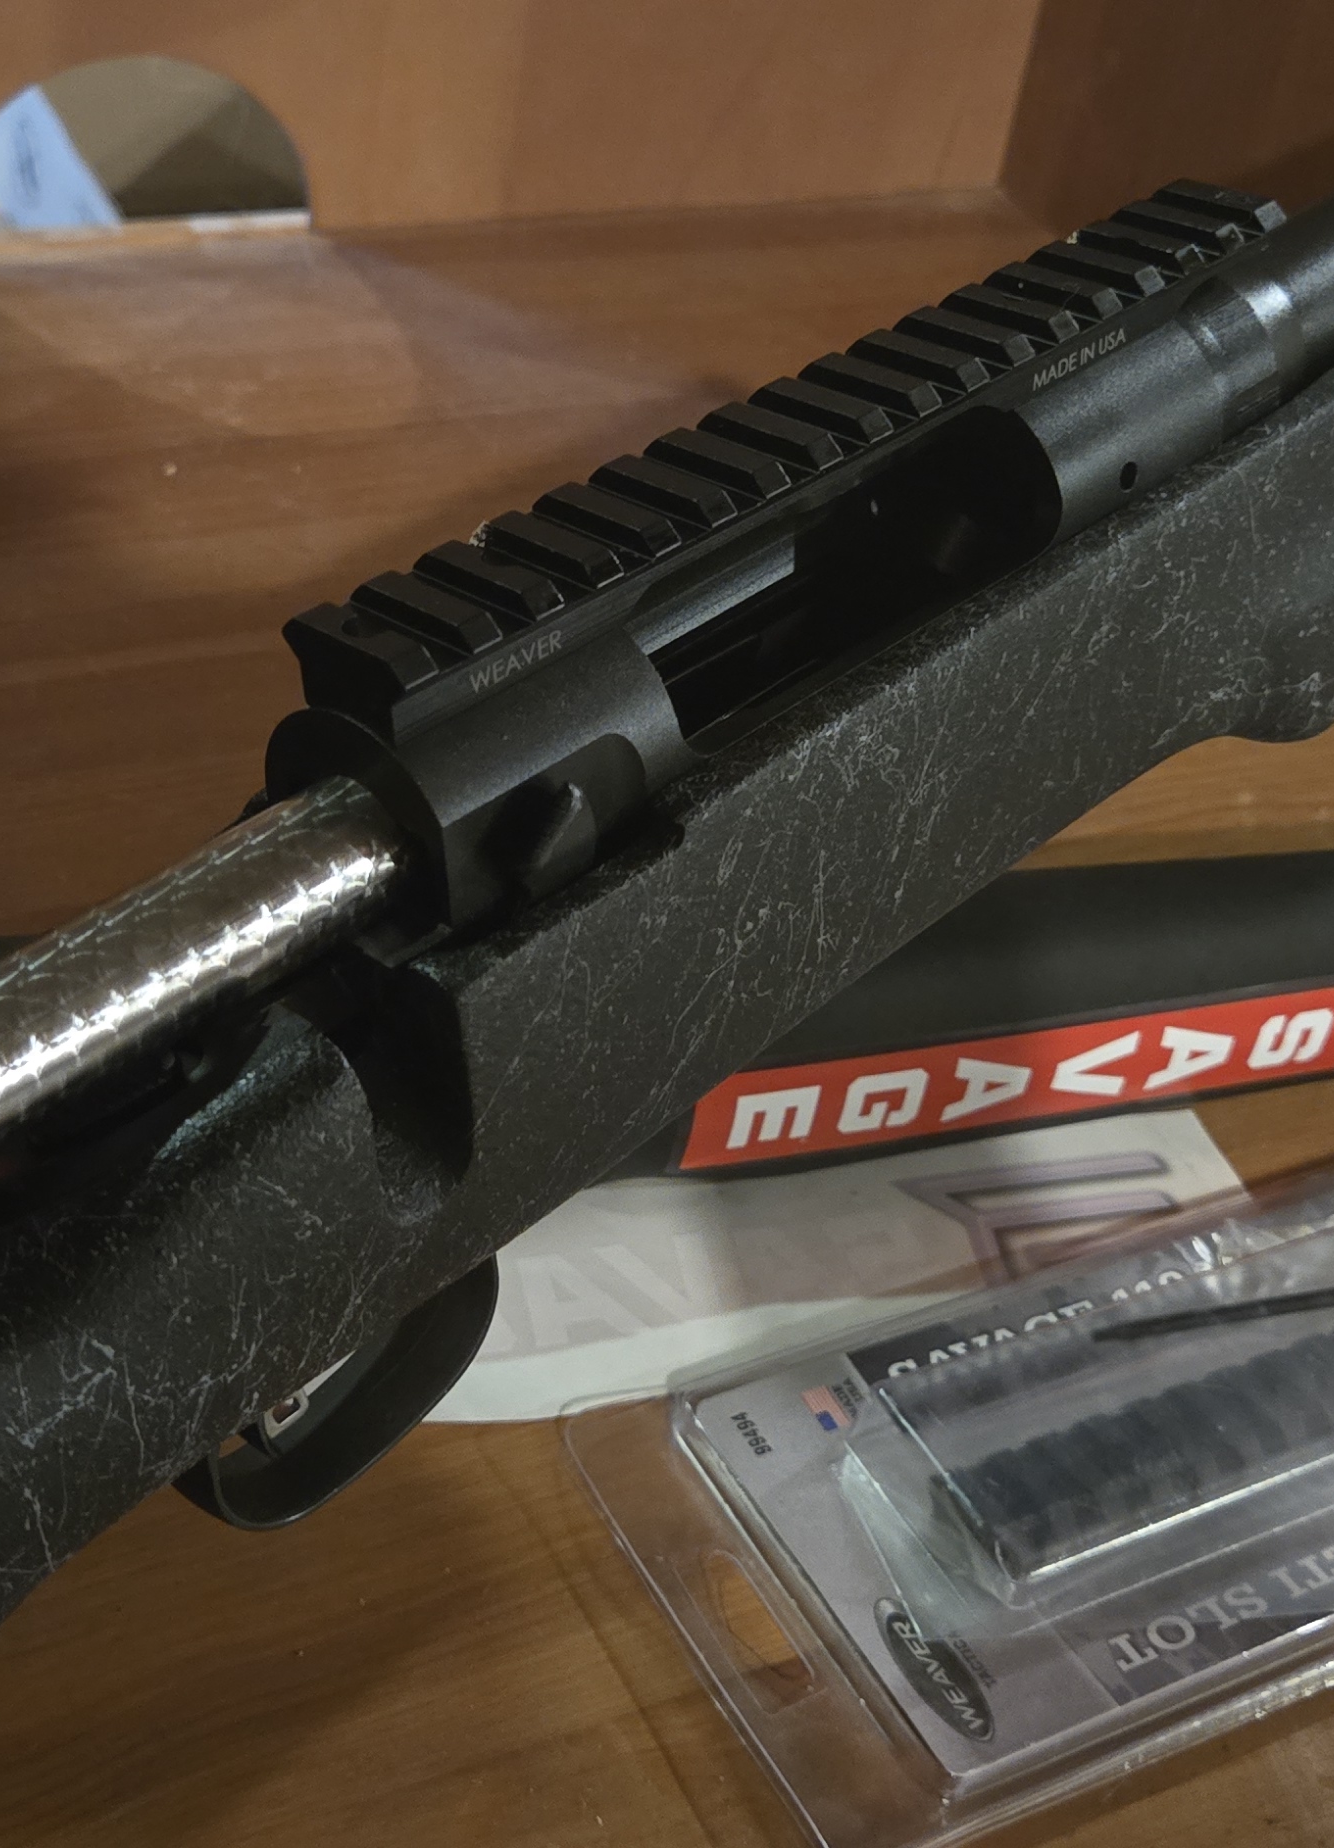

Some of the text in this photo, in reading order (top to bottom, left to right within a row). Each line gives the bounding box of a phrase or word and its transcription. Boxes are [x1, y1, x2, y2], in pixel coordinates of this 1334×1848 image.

[1032, 328, 1126, 391] MADE IN USA
[470, 628, 564, 693] WEAVER
[730, 1411, 773, 1455] 99494
[1109, 1582, 1269, 1671] SLOT
[891, 1621, 984, 1730] WEAVER
